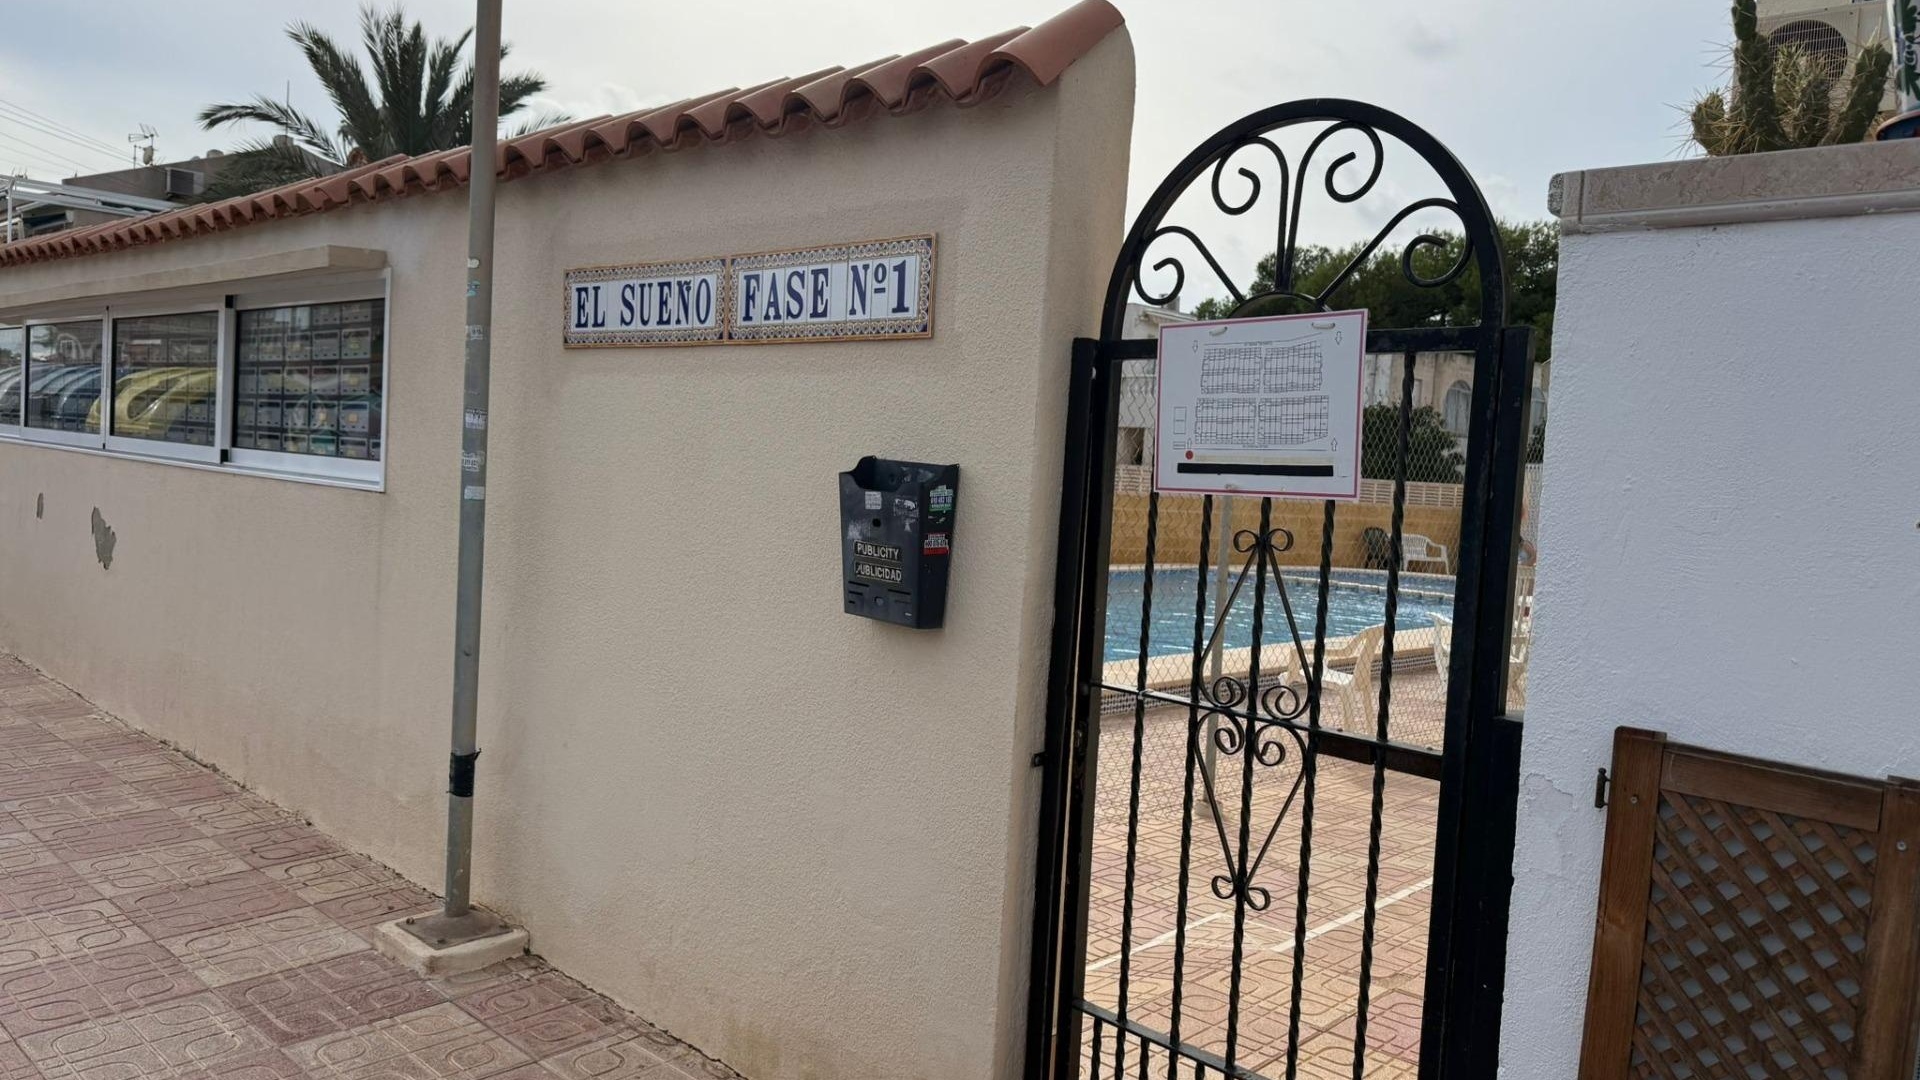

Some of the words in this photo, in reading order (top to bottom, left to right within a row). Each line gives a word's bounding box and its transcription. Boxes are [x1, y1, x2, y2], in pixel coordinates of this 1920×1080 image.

[575, 285, 606, 329] EL
[620, 278, 712, 327] SUEÑO
[742, 267, 829, 322] FASE
[857, 543, 899, 560] PUBLICITY
